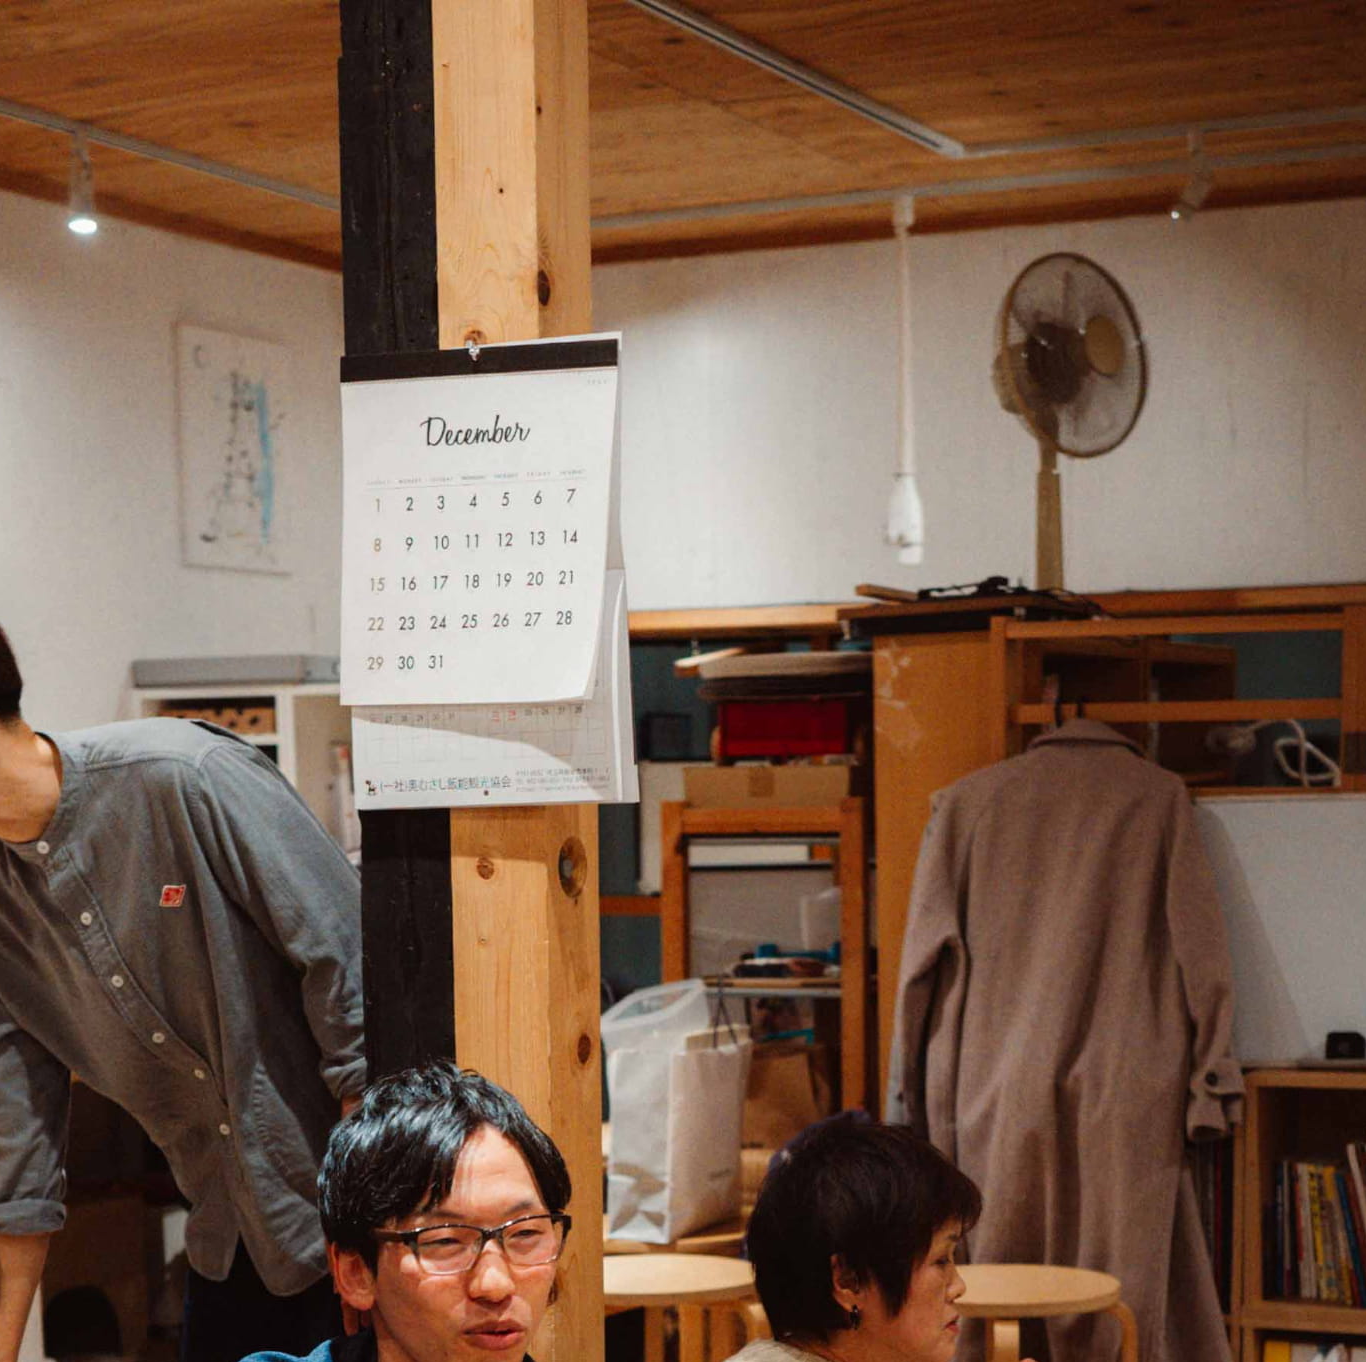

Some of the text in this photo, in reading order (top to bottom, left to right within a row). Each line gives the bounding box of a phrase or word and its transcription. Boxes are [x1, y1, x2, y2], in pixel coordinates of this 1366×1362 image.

[420, 414, 532, 447] December
[375, 487, 577, 513] 1 2 3 4 5 6 7
[373, 529, 579, 553] 8 9 10 11 12 13 14
[370, 569, 574, 592] 15 16 17 18 19 20 21
[367, 609, 573, 632] 22 23 24 25 26 27 28
[366, 654, 444, 671] 29 30 31
